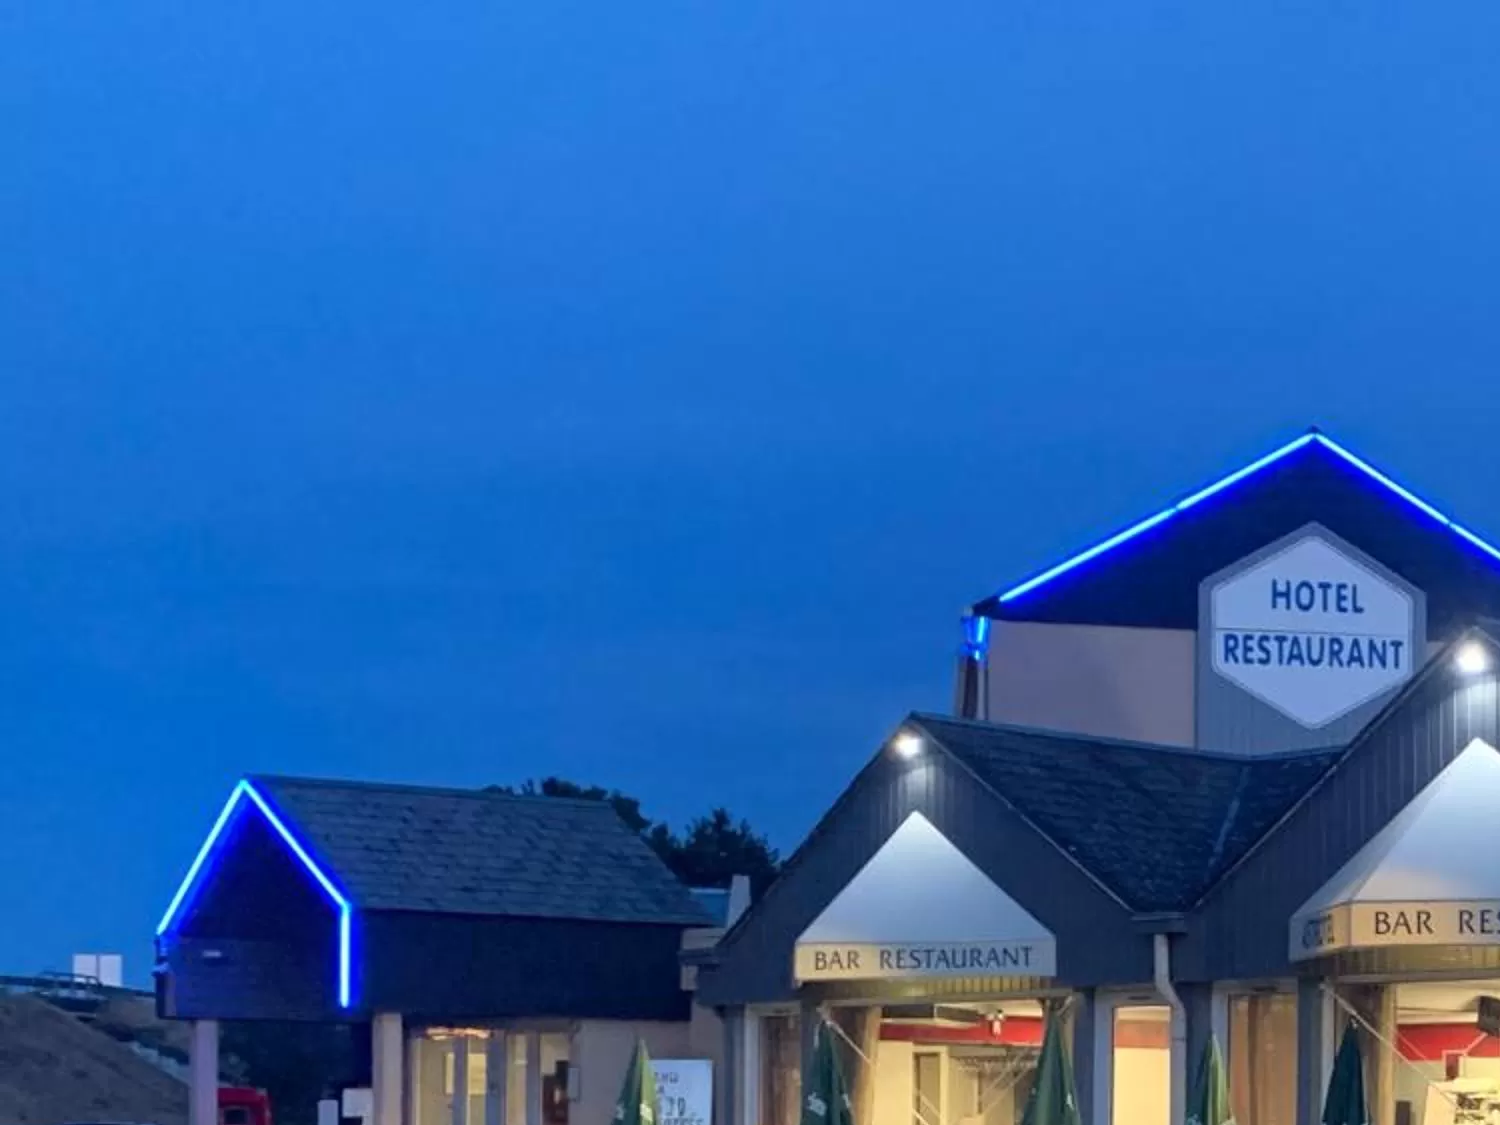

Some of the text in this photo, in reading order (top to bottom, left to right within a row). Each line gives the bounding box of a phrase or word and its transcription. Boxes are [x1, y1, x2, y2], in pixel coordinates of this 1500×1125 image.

[1271, 578, 1364, 614] HOTEL
[1223, 633, 1404, 670] RESTAURANT
[1374, 910, 1434, 935] BAR
[814, 946, 1033, 971] BAR RESTAURANT
